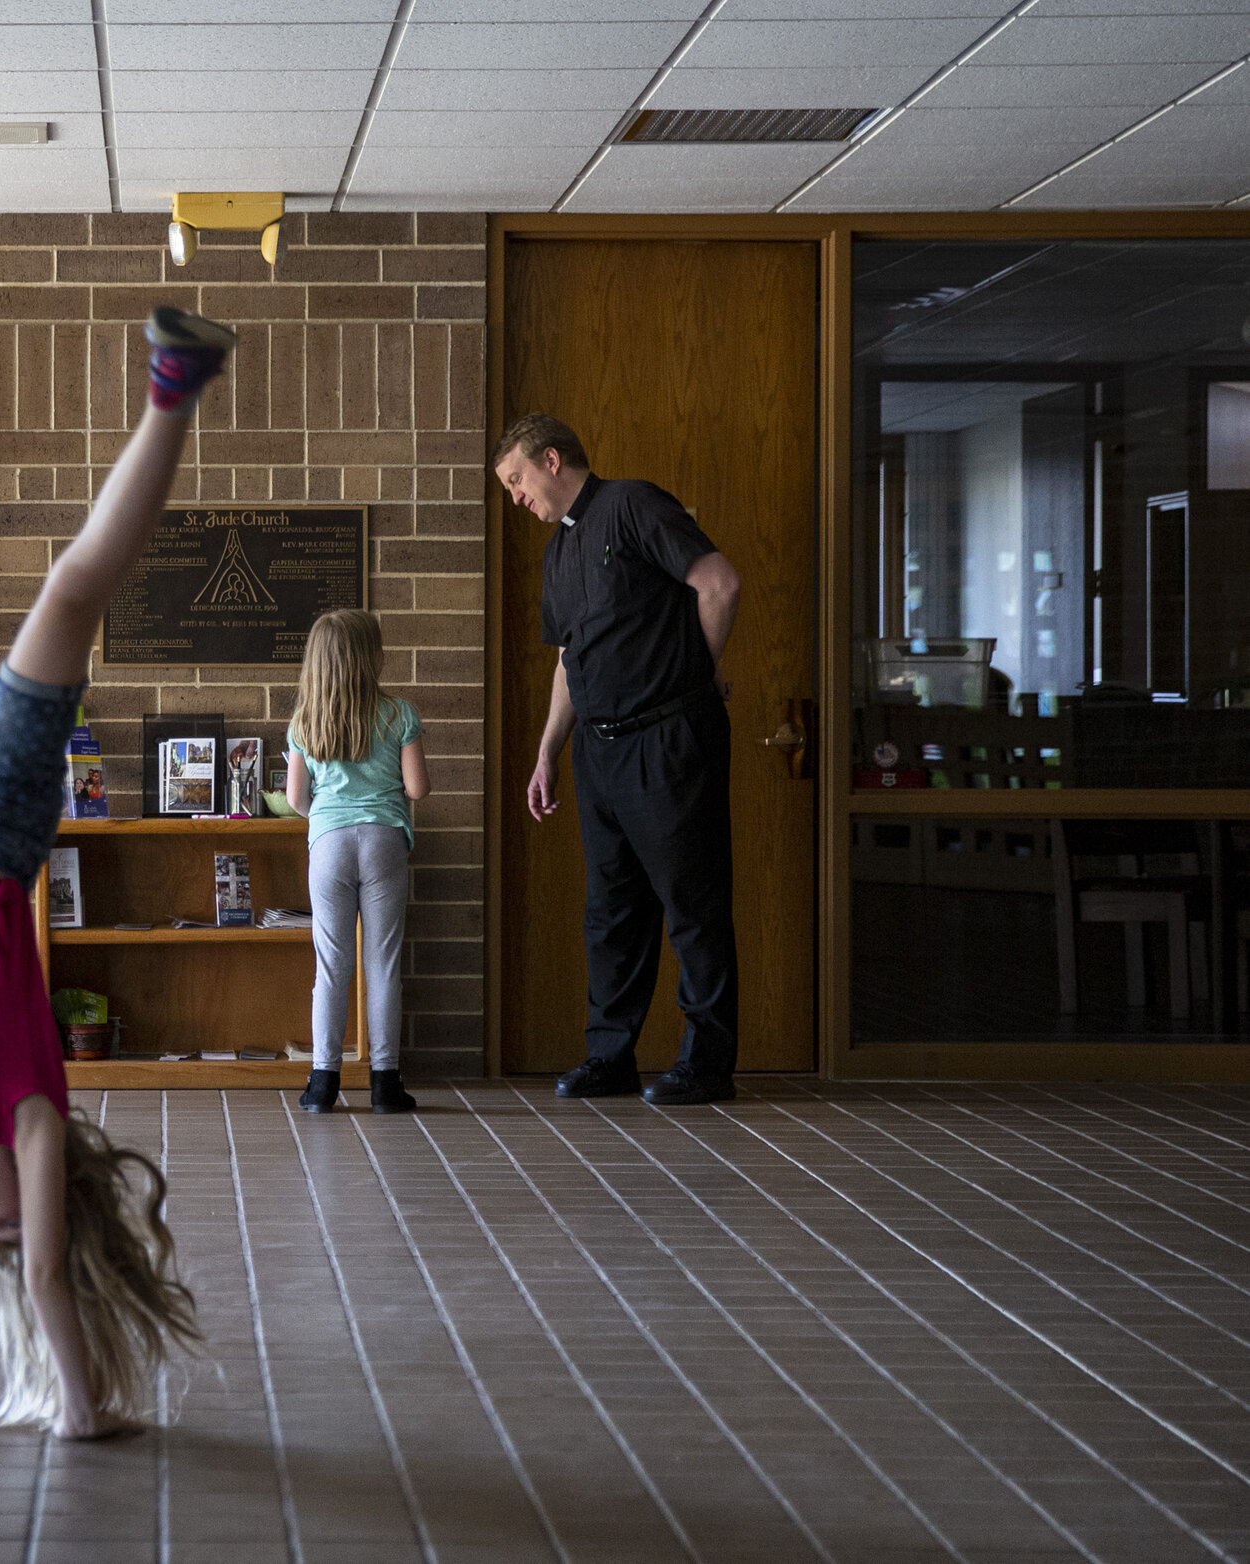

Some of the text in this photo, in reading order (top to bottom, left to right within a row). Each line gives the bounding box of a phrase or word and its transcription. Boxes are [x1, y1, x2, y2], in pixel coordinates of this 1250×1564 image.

[183, 511, 290, 528] St. Jude Church
